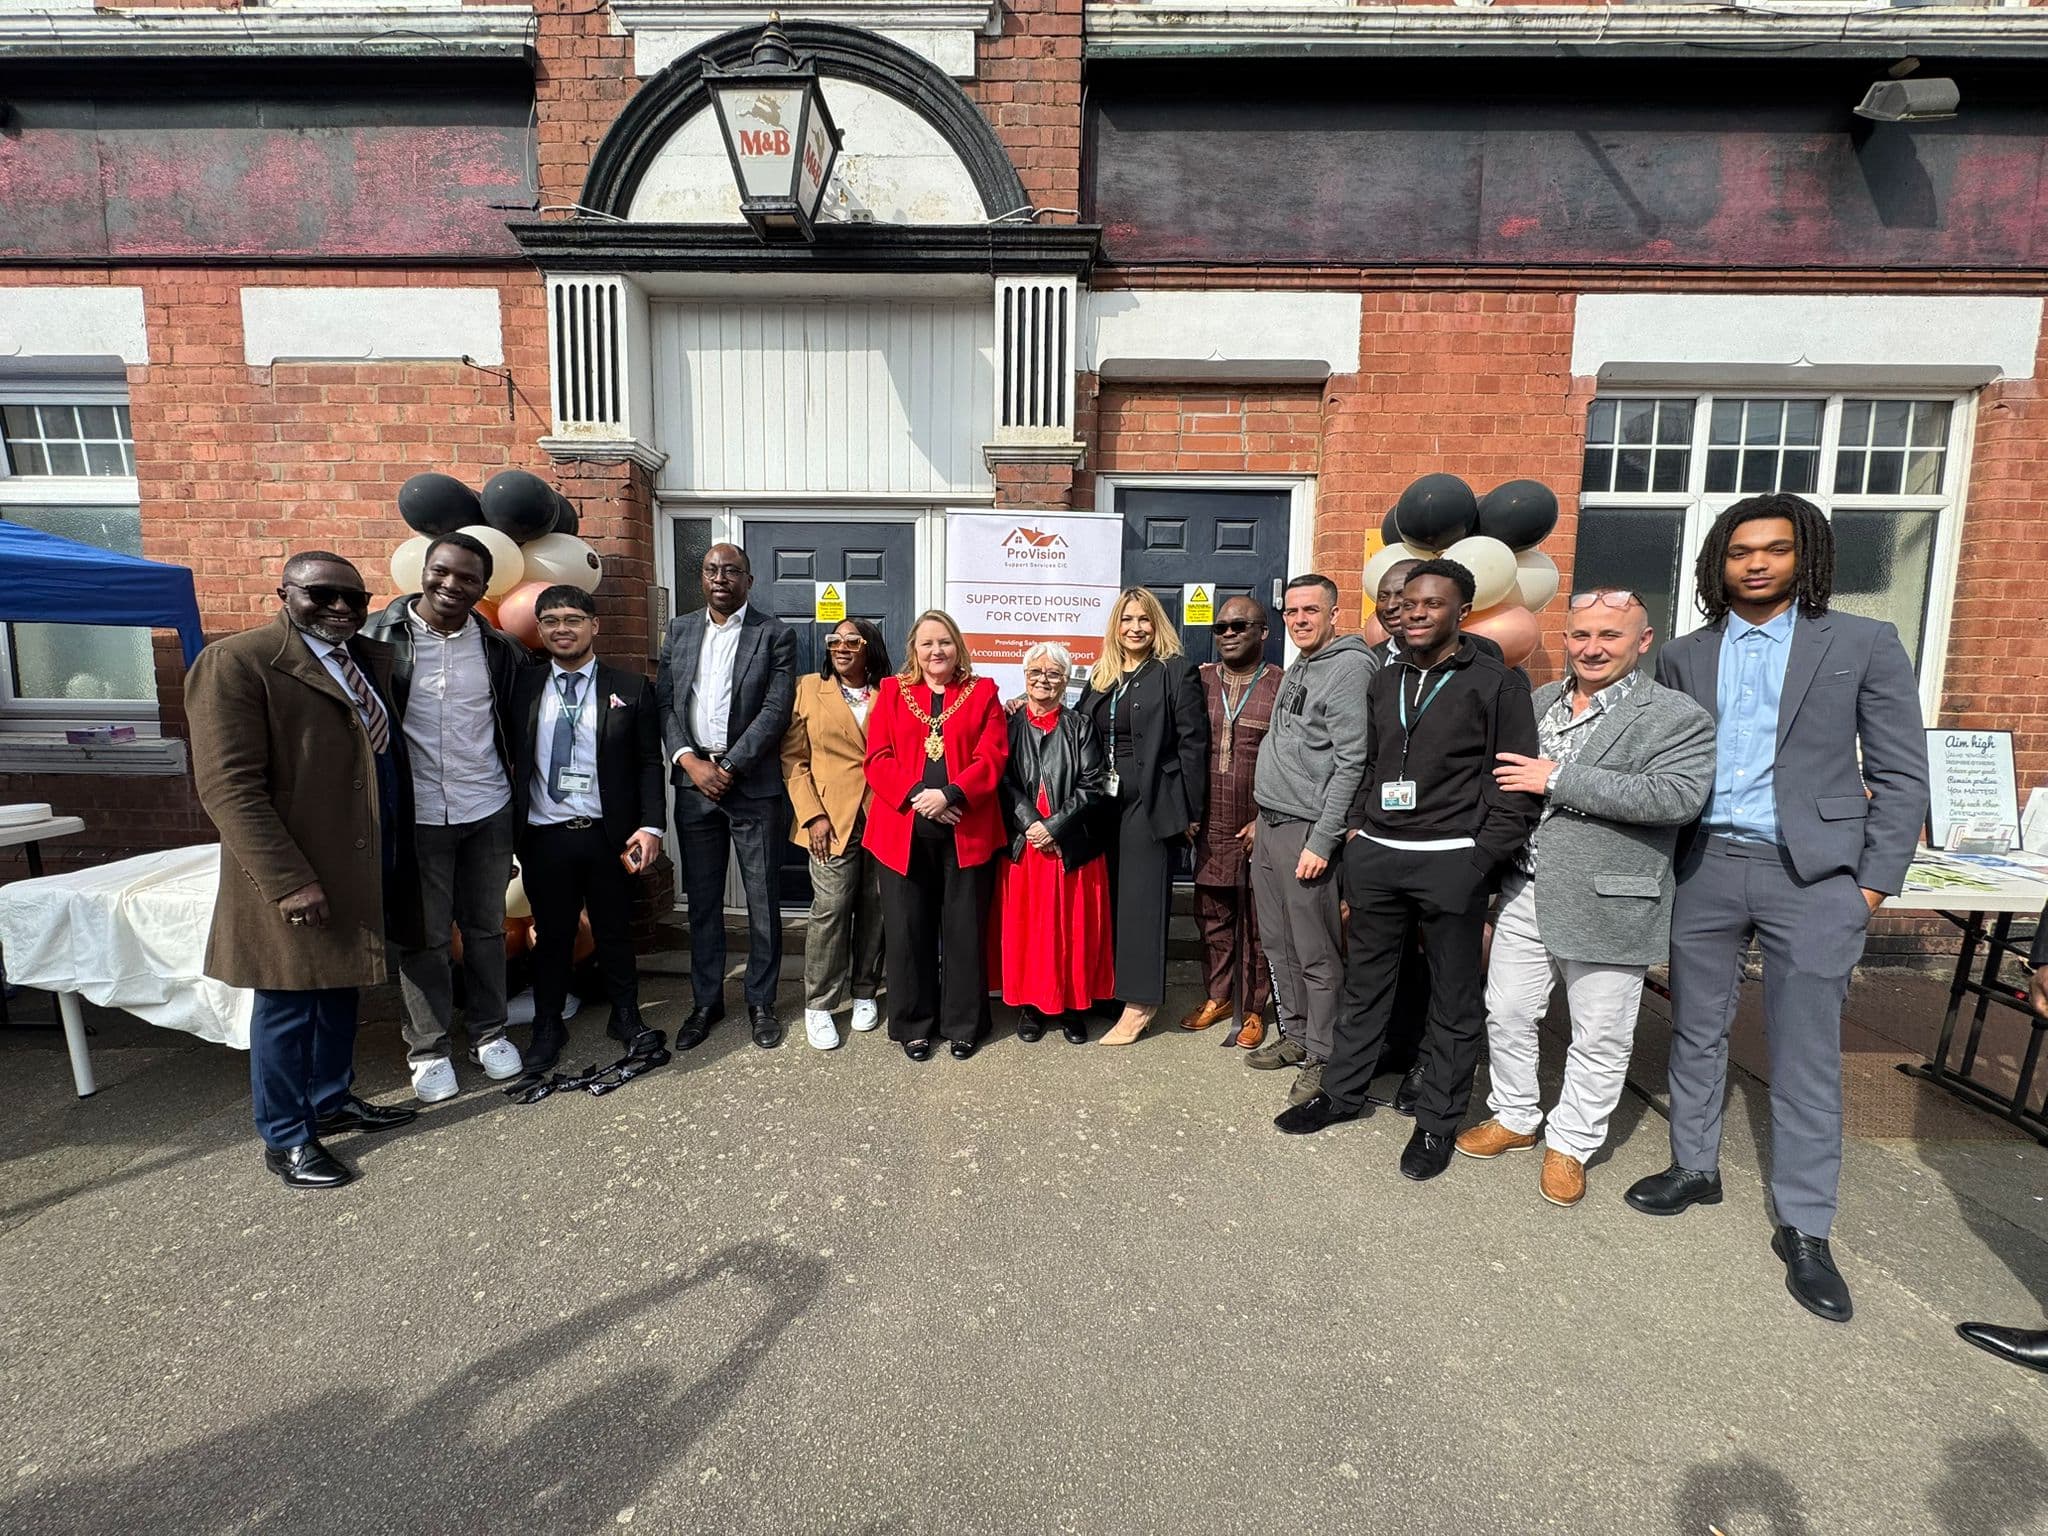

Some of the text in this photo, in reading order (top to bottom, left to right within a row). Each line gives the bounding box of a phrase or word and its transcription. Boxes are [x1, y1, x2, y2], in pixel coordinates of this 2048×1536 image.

[738, 129, 790, 156] M&B
[804, 141, 822, 188] M&B
[1007, 548, 1066, 560] ProVision
[966, 593, 1101, 607] SUPPORTED HOUSING
[986, 611, 1081, 623] FOR COVENTRY
[995, 639, 1023, 647] Providing
[1945, 735, 1997, 754] Aim high
